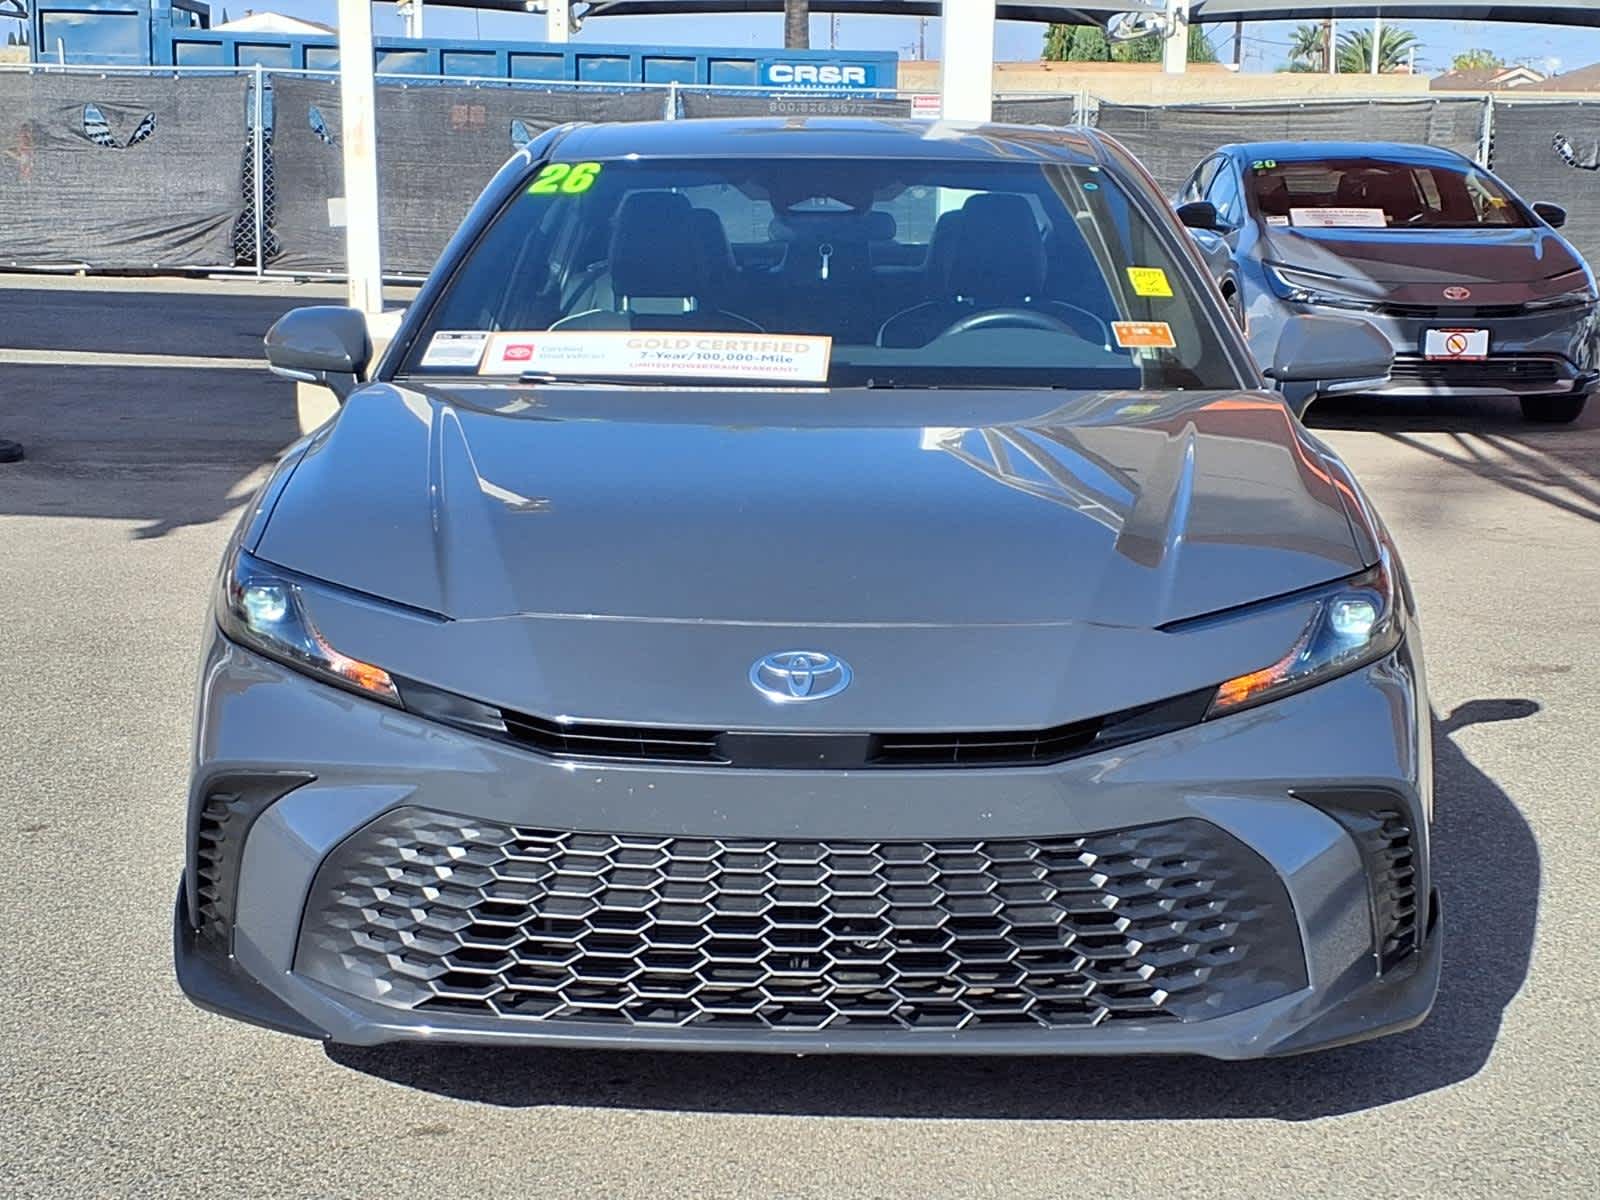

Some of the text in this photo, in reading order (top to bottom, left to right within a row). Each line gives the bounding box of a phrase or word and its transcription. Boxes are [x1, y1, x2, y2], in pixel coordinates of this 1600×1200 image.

[769, 64, 866, 84] CR&R
[527, 162, 601, 193] 26
[626, 338, 810, 353] GOLD CERTIFIED
[640, 351, 793, 363] 7-Year/100,000-Mile
